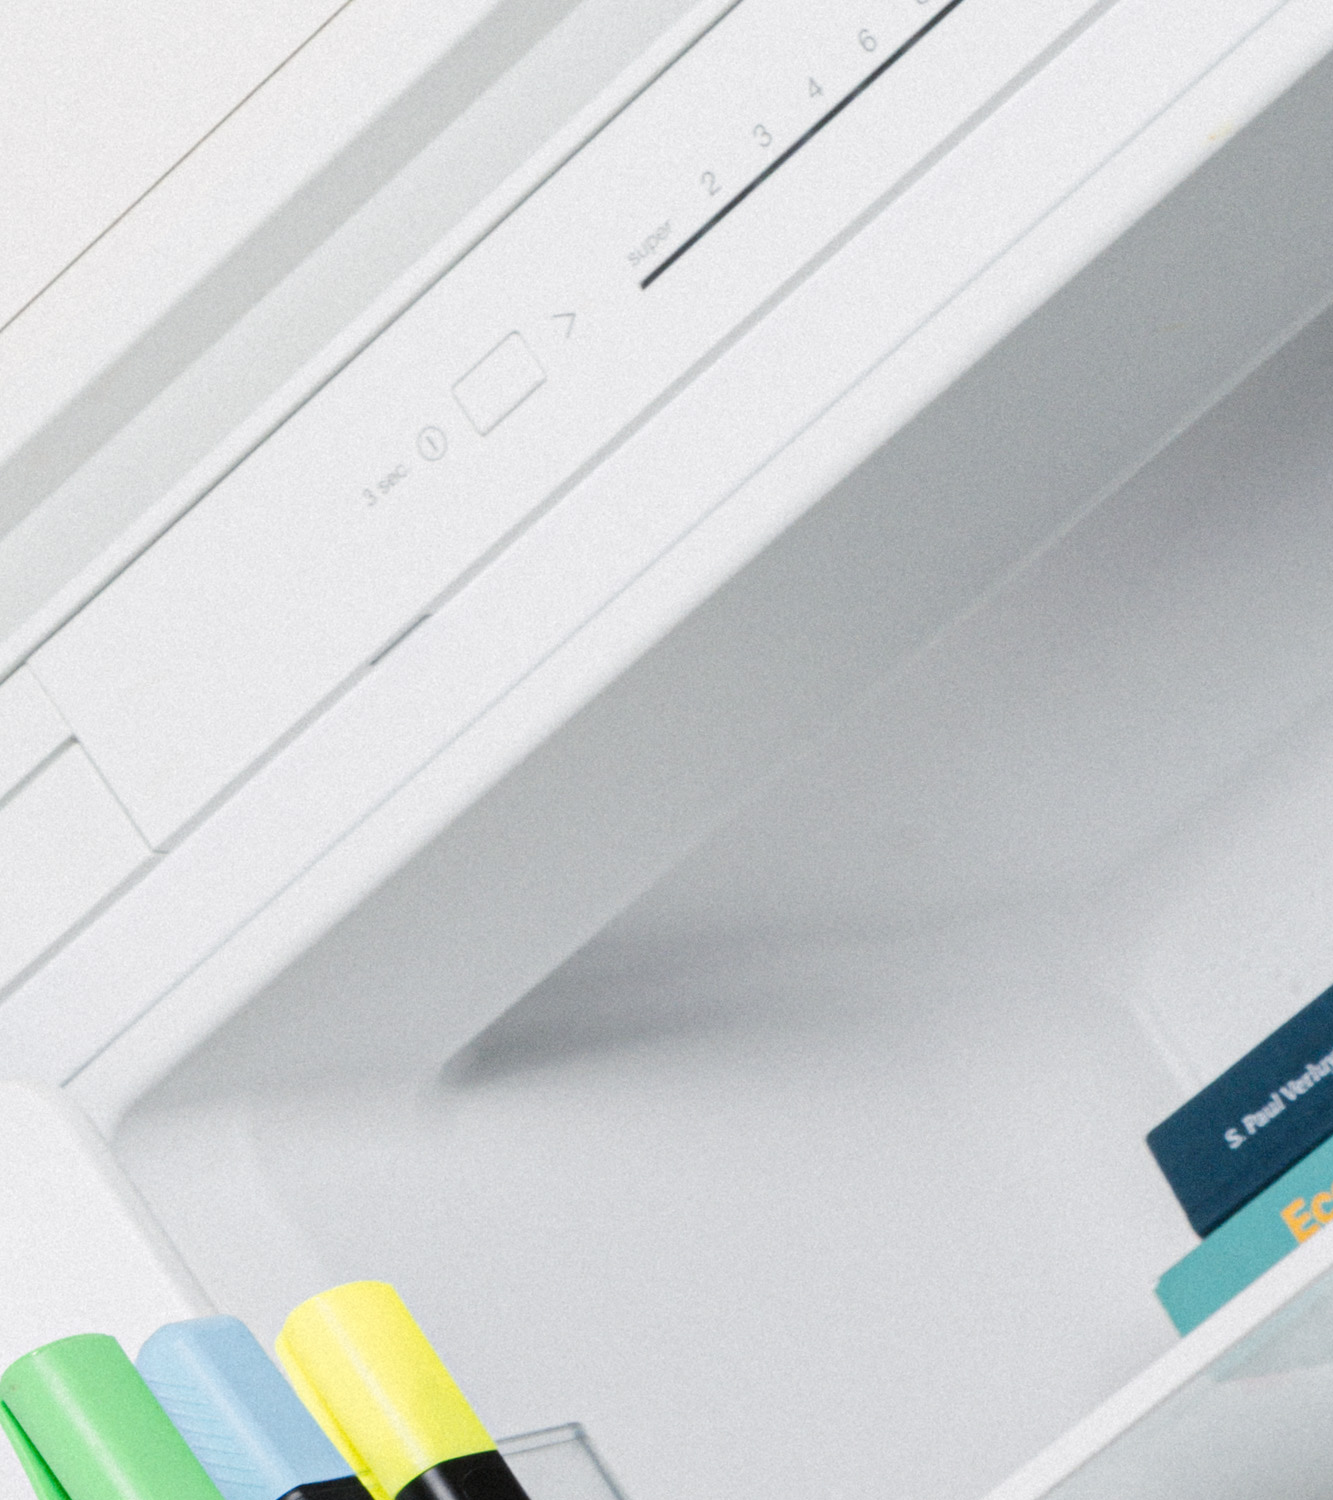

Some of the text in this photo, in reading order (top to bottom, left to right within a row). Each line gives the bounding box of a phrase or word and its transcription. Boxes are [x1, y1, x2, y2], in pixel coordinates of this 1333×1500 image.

[857, 28, 877, 52] 6
[808, 76, 824, 99] 4
[753, 124, 772, 147] 3
[701, 171, 722, 197] 2
[628, 221, 671, 266] super
[1224, 1126, 1248, 1150] S.
[1241, 1094, 1287, 1136] Paul
